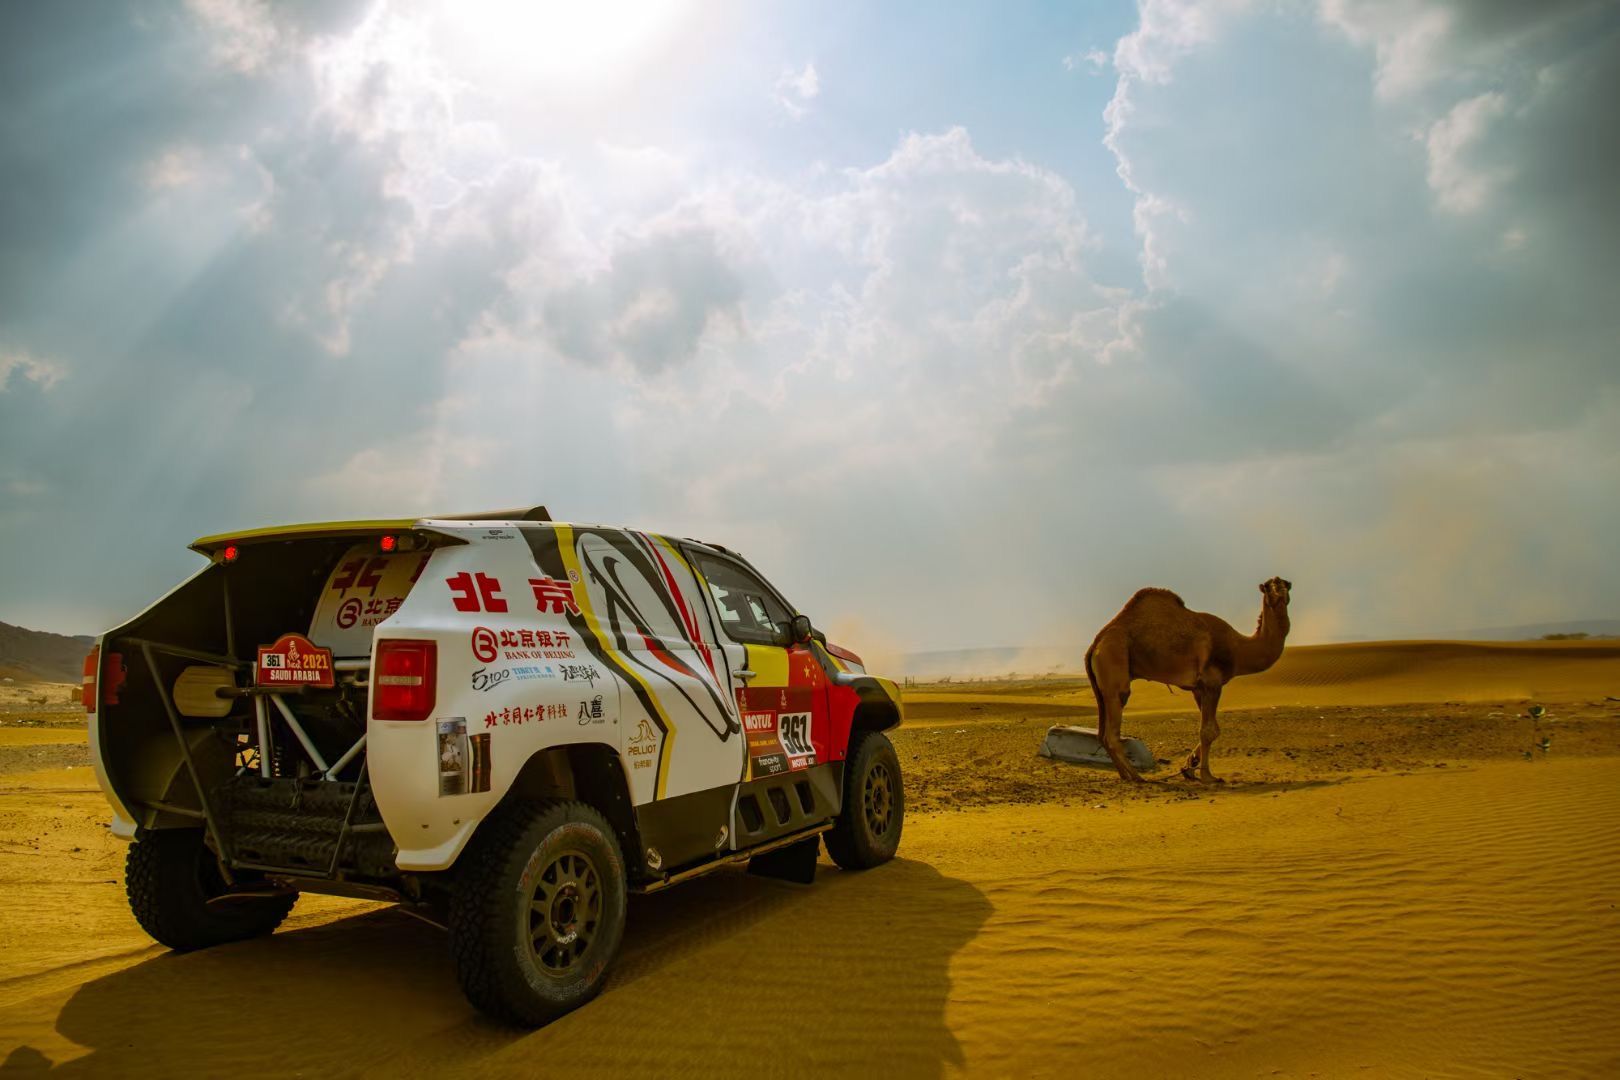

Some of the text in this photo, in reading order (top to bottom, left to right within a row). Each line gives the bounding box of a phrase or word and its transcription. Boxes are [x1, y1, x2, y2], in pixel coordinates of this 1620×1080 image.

[445, 571, 583, 616] 北京
[500, 628, 571, 649] 北京银行
[266, 655, 281, 667] 361
[302, 653, 329, 669] 2021
[504, 650, 576, 660] BANK OF BEIJING
[270, 669, 321, 681] SAUDI ARABIA
[471, 666, 511, 692] 5100
[483, 703, 568, 729] 北京同仁堂科技
[578, 696, 603, 723] 八喜
[744, 713, 773, 730] MOTUL
[780, 714, 815, 755] 361
[627, 744, 657, 756] PELLIOT
[791, 758, 808, 768] MOTUL
